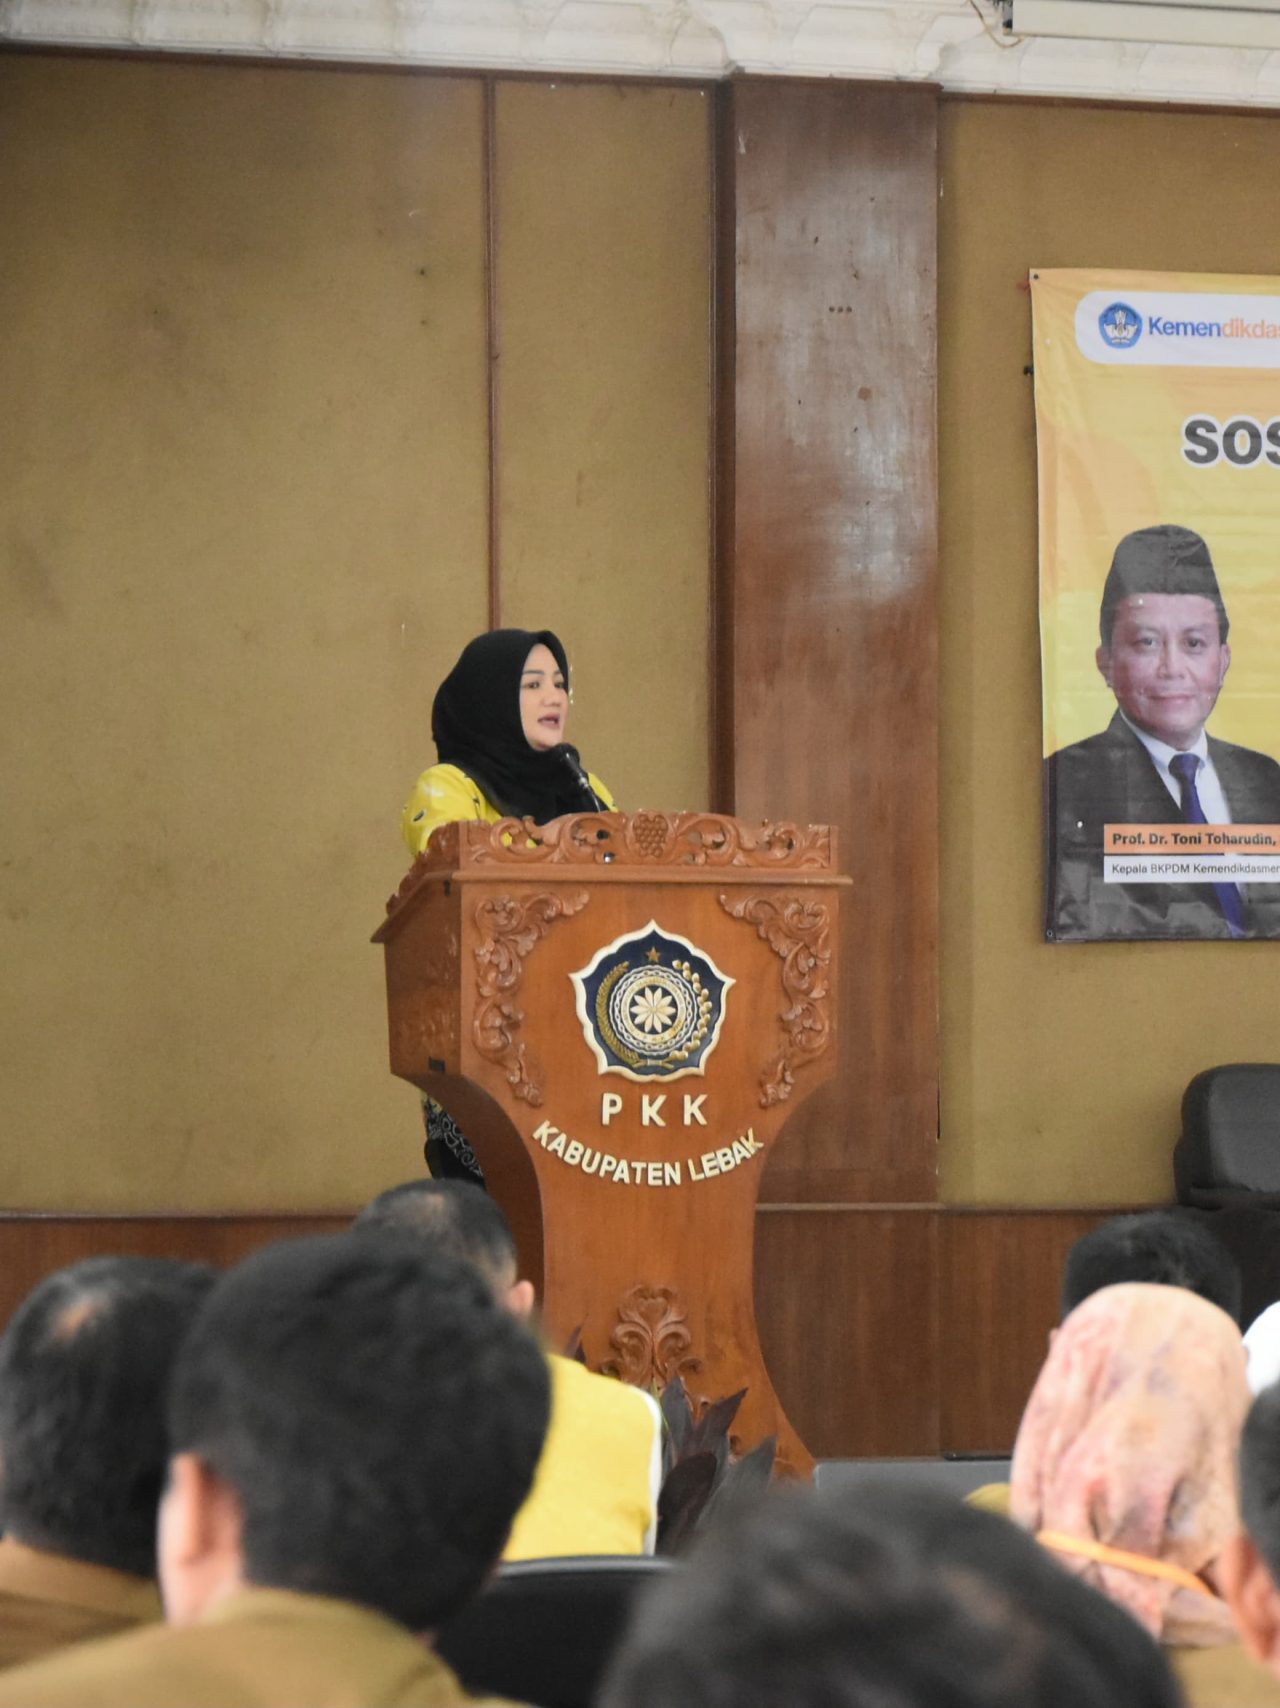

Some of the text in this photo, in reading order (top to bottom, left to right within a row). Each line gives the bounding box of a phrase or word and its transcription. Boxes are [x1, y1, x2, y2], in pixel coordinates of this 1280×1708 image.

[1113, 833, 1145, 845] Prof.
[1149, 833, 1168, 845] Dr.
[1173, 833, 1201, 845] Toni
[1205, 833, 1276, 846] Toharudin,
[1112, 863, 1147, 874] Kepala
[1151, 864, 1190, 874] BKPDM
[532, 1120, 764, 1186] KABUPATEN LEBAK
